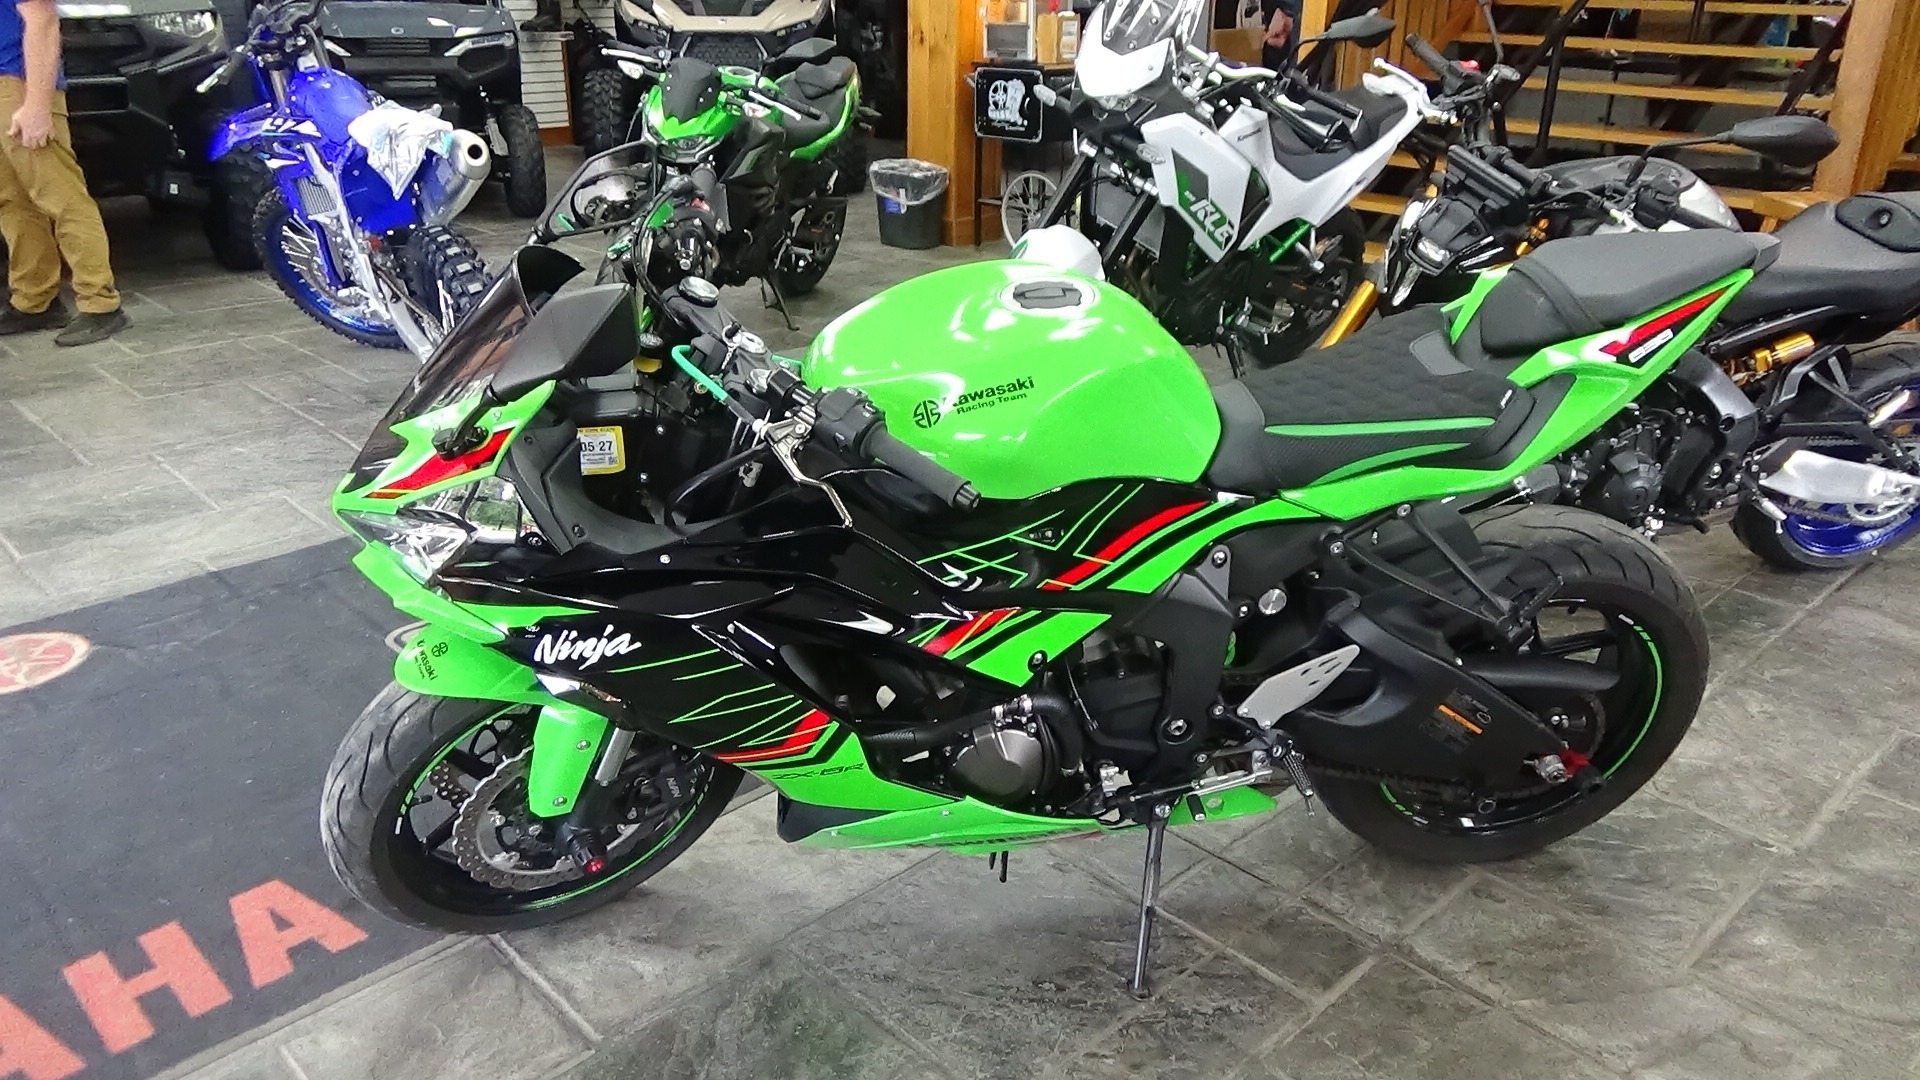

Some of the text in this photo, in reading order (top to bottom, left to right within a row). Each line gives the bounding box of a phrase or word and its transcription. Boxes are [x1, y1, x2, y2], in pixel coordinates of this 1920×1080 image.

[942, 376, 1035, 408] awasaki
[956, 392, 1028, 415] Racing Team
[580, 440, 613, 453] 05 27
[416, 638, 438, 681] Kwasaki
[533, 623, 643, 671] Ninja
